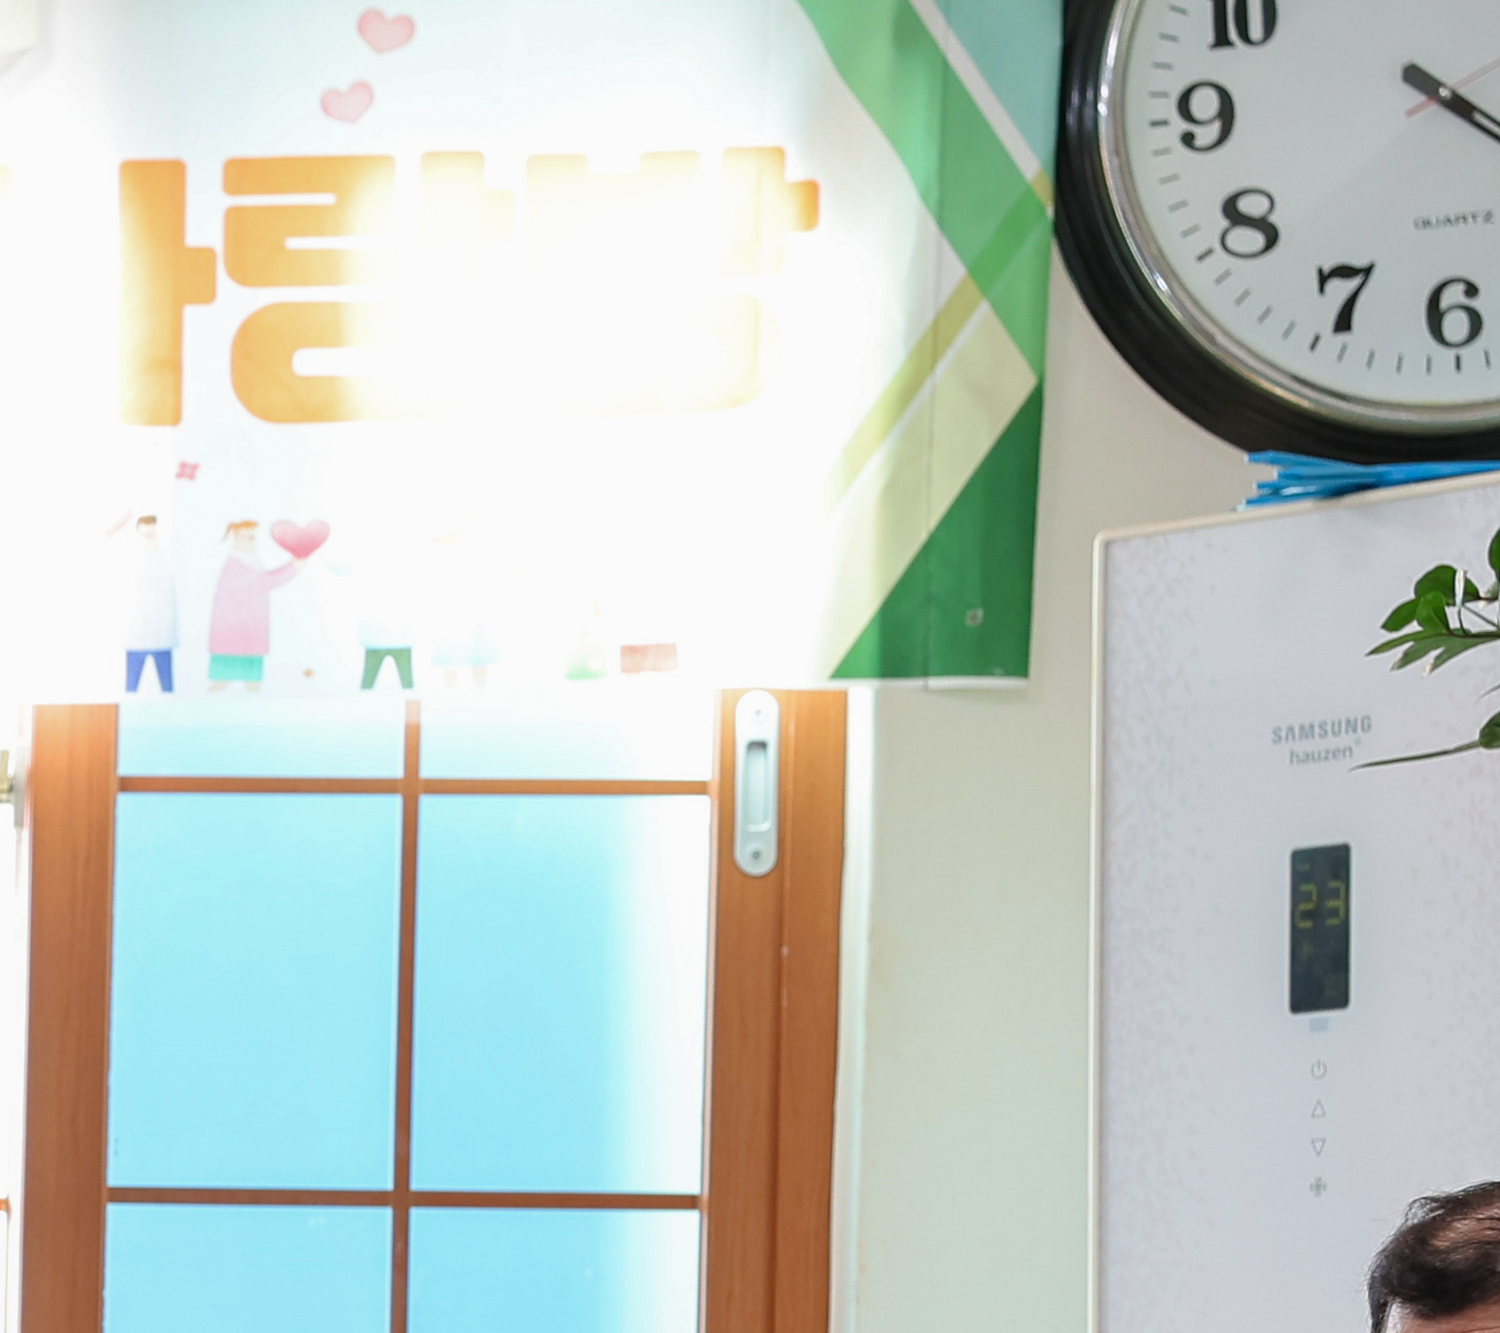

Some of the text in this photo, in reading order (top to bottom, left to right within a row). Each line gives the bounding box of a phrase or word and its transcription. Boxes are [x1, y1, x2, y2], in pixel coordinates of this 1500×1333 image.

[1209, 0, 1279, 49] 10
[1177, 81, 1236, 152] 9
[1221, 188, 1279, 258] 8
[1414, 209, 1496, 232] QUARTZ
[1317, 260, 1376, 334] 7
[1425, 278, 1483, 348] 6
[1271, 714, 1373, 745] SAMSUNG
[1289, 746, 1354, 765] hauzen
[1295, 880, 1346, 929] 23
